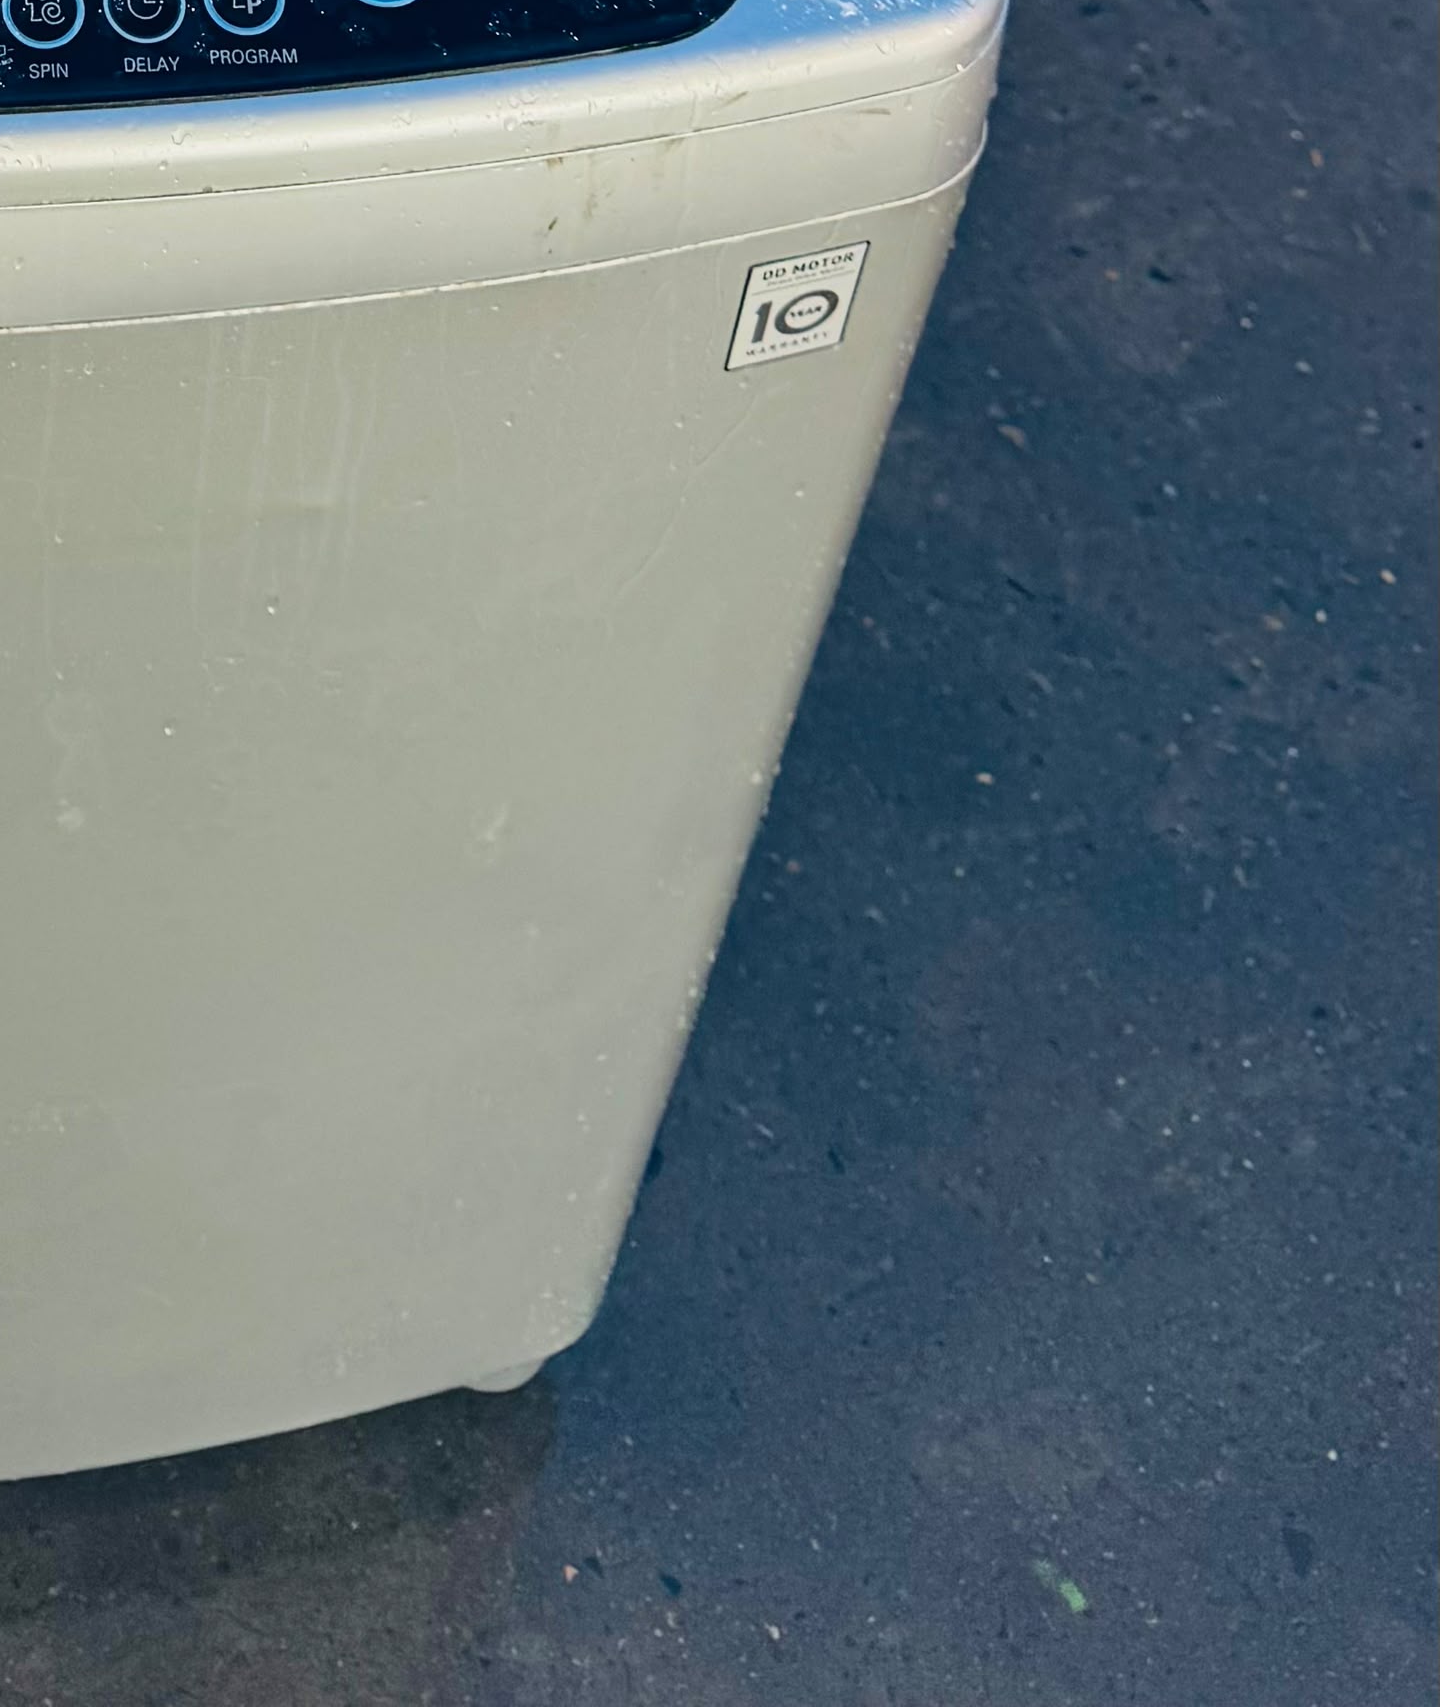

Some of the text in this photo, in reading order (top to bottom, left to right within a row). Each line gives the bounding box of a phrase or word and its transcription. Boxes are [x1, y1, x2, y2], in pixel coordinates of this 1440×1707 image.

[124, 56, 180, 73] DELAY
[209, 48, 299, 66] PROGRAM
[28, 63, 69, 79] SPIN
[762, 268, 787, 281] DD
[792, 251, 854, 275] MOTOR
[751, 289, 839, 343] 10
[789, 305, 823, 318] YEAR
